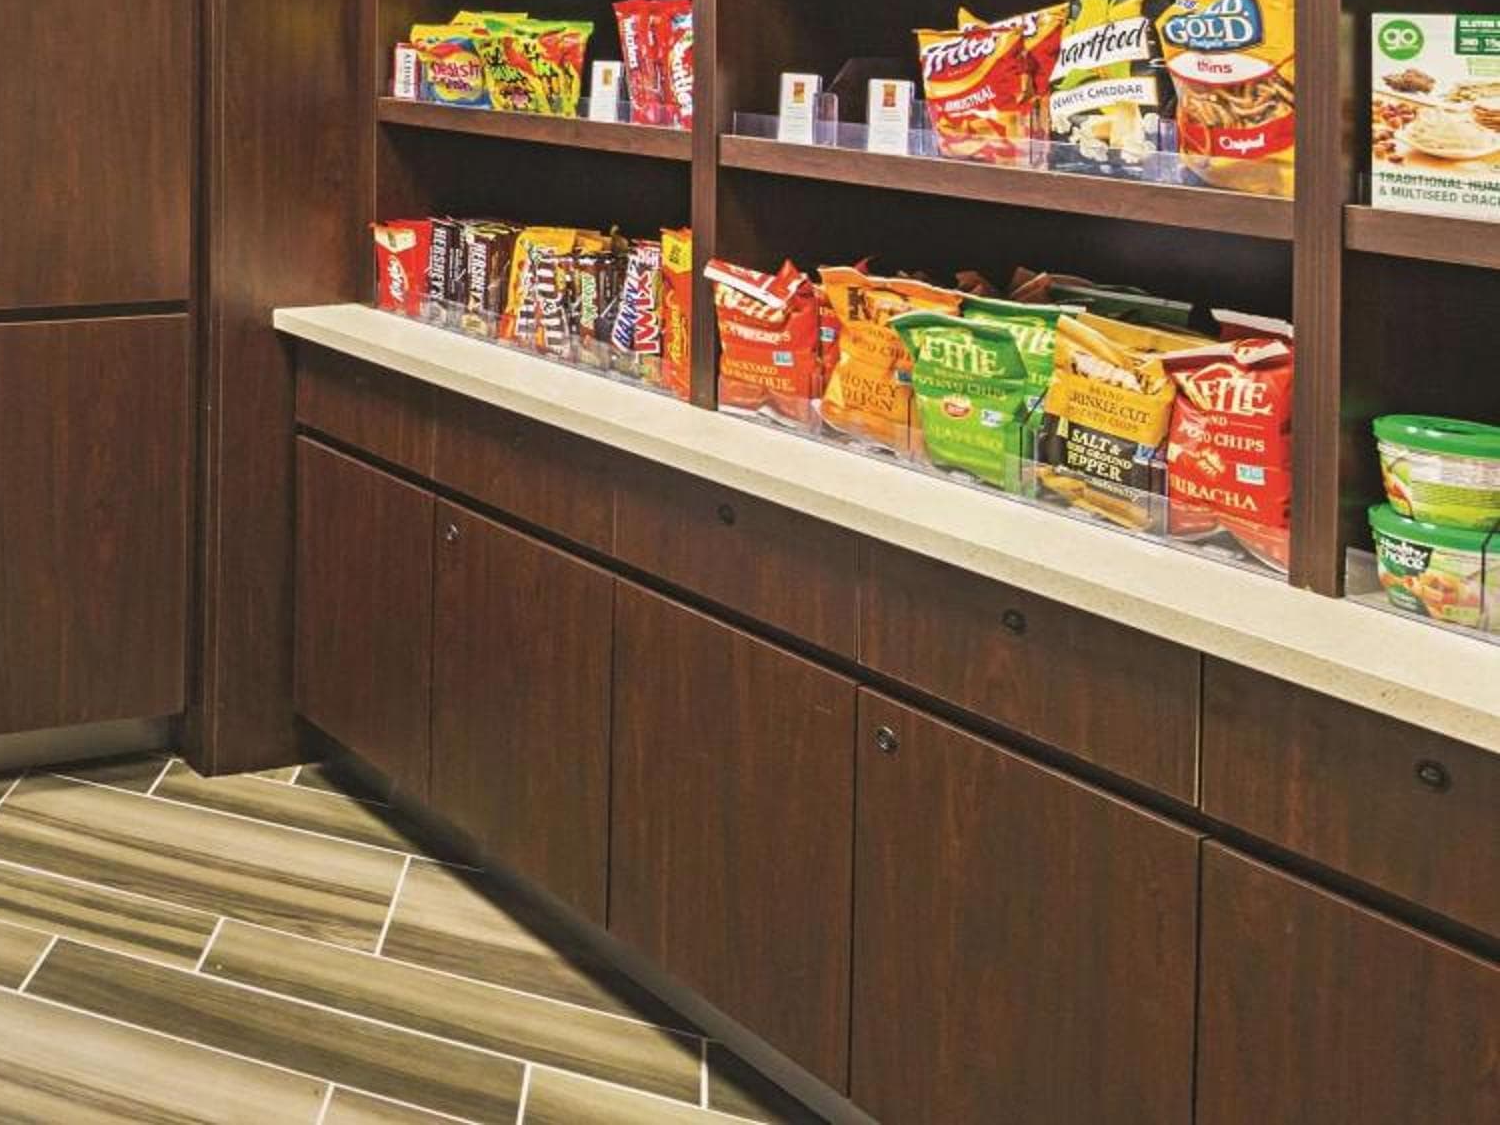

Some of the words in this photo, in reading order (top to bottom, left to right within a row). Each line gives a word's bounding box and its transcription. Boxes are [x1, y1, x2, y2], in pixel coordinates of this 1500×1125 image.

[1165, 15, 1253, 44] GOLD
[1060, 19, 1147, 67] artfood
[1196, 58, 1233, 74] thins
[1086, 83, 1144, 100] CHEDDAR
[1380, 172, 1463, 189] TRADITIONAL
[1391, 186, 1457, 202] MULTISEED
[634, 270, 660, 355] TWIX
[1071, 428, 1112, 452] SALT
[1213, 432, 1266, 453] CHIPS
[1171, 475, 1259, 512] IRACHA
